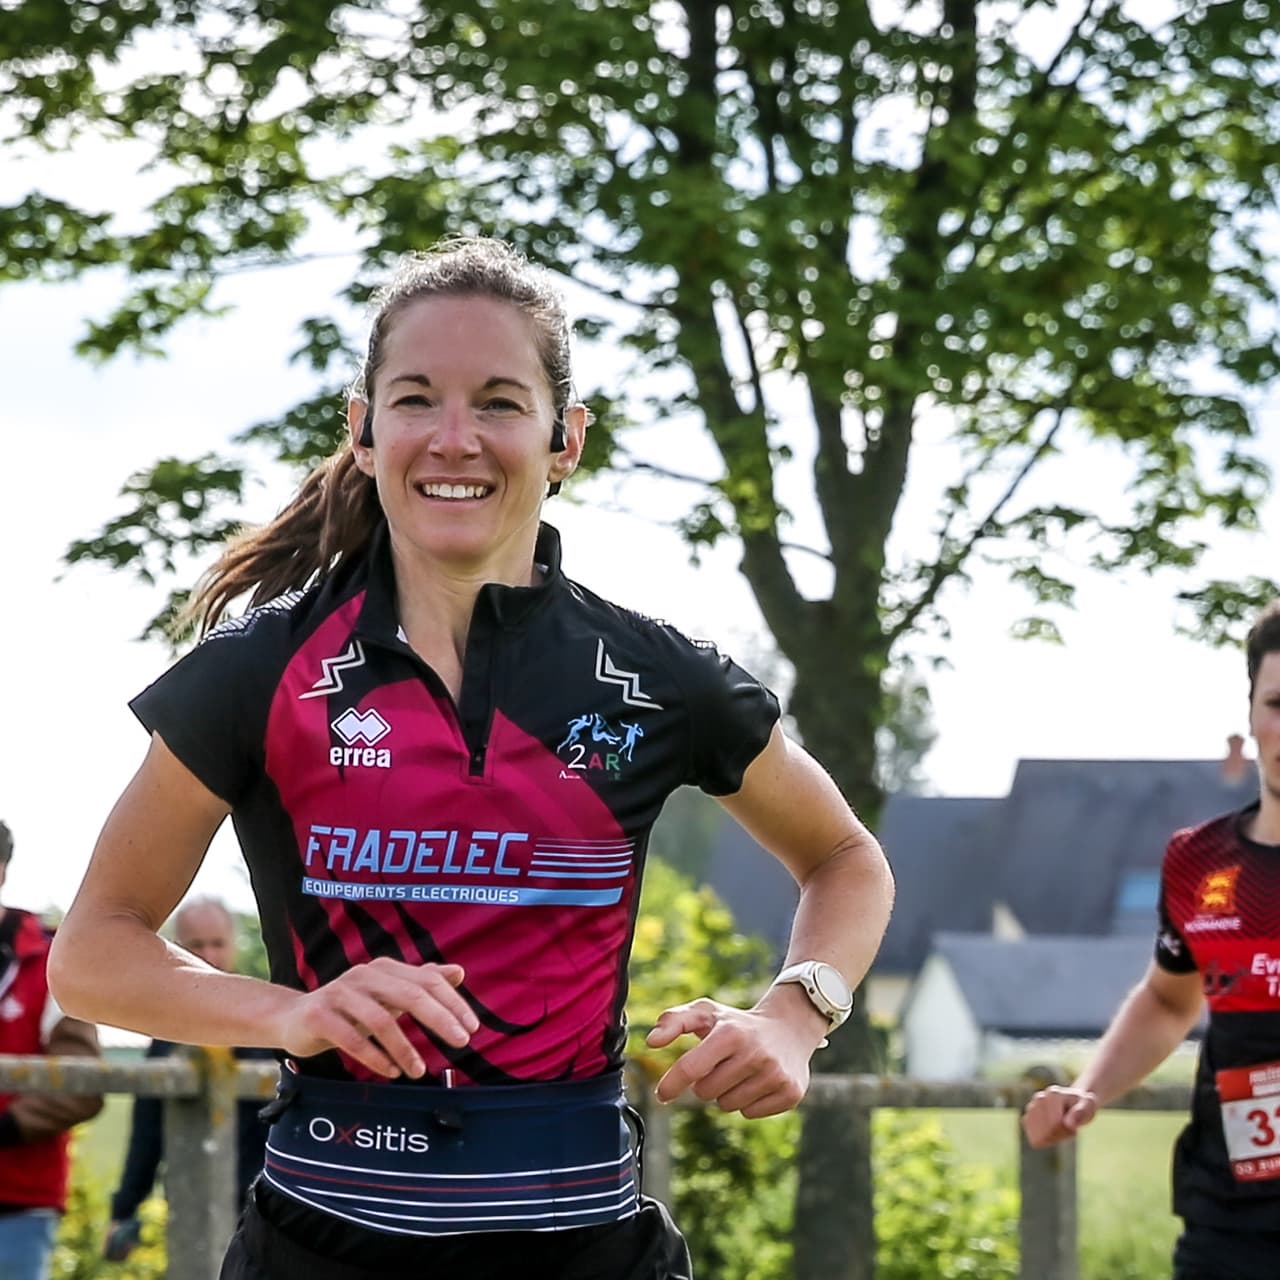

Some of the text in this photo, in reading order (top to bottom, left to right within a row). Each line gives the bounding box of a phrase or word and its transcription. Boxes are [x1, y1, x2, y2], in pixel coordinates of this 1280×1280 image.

[329, 746, 391, 768] errea
[567, 743, 621, 771] 2AR
[305, 825, 528, 876] FRADELEC
[305, 880, 519, 902] EQUIPEMENTS ELECTRIQUES
[309, 1117, 429, 1153] Oxsitis
